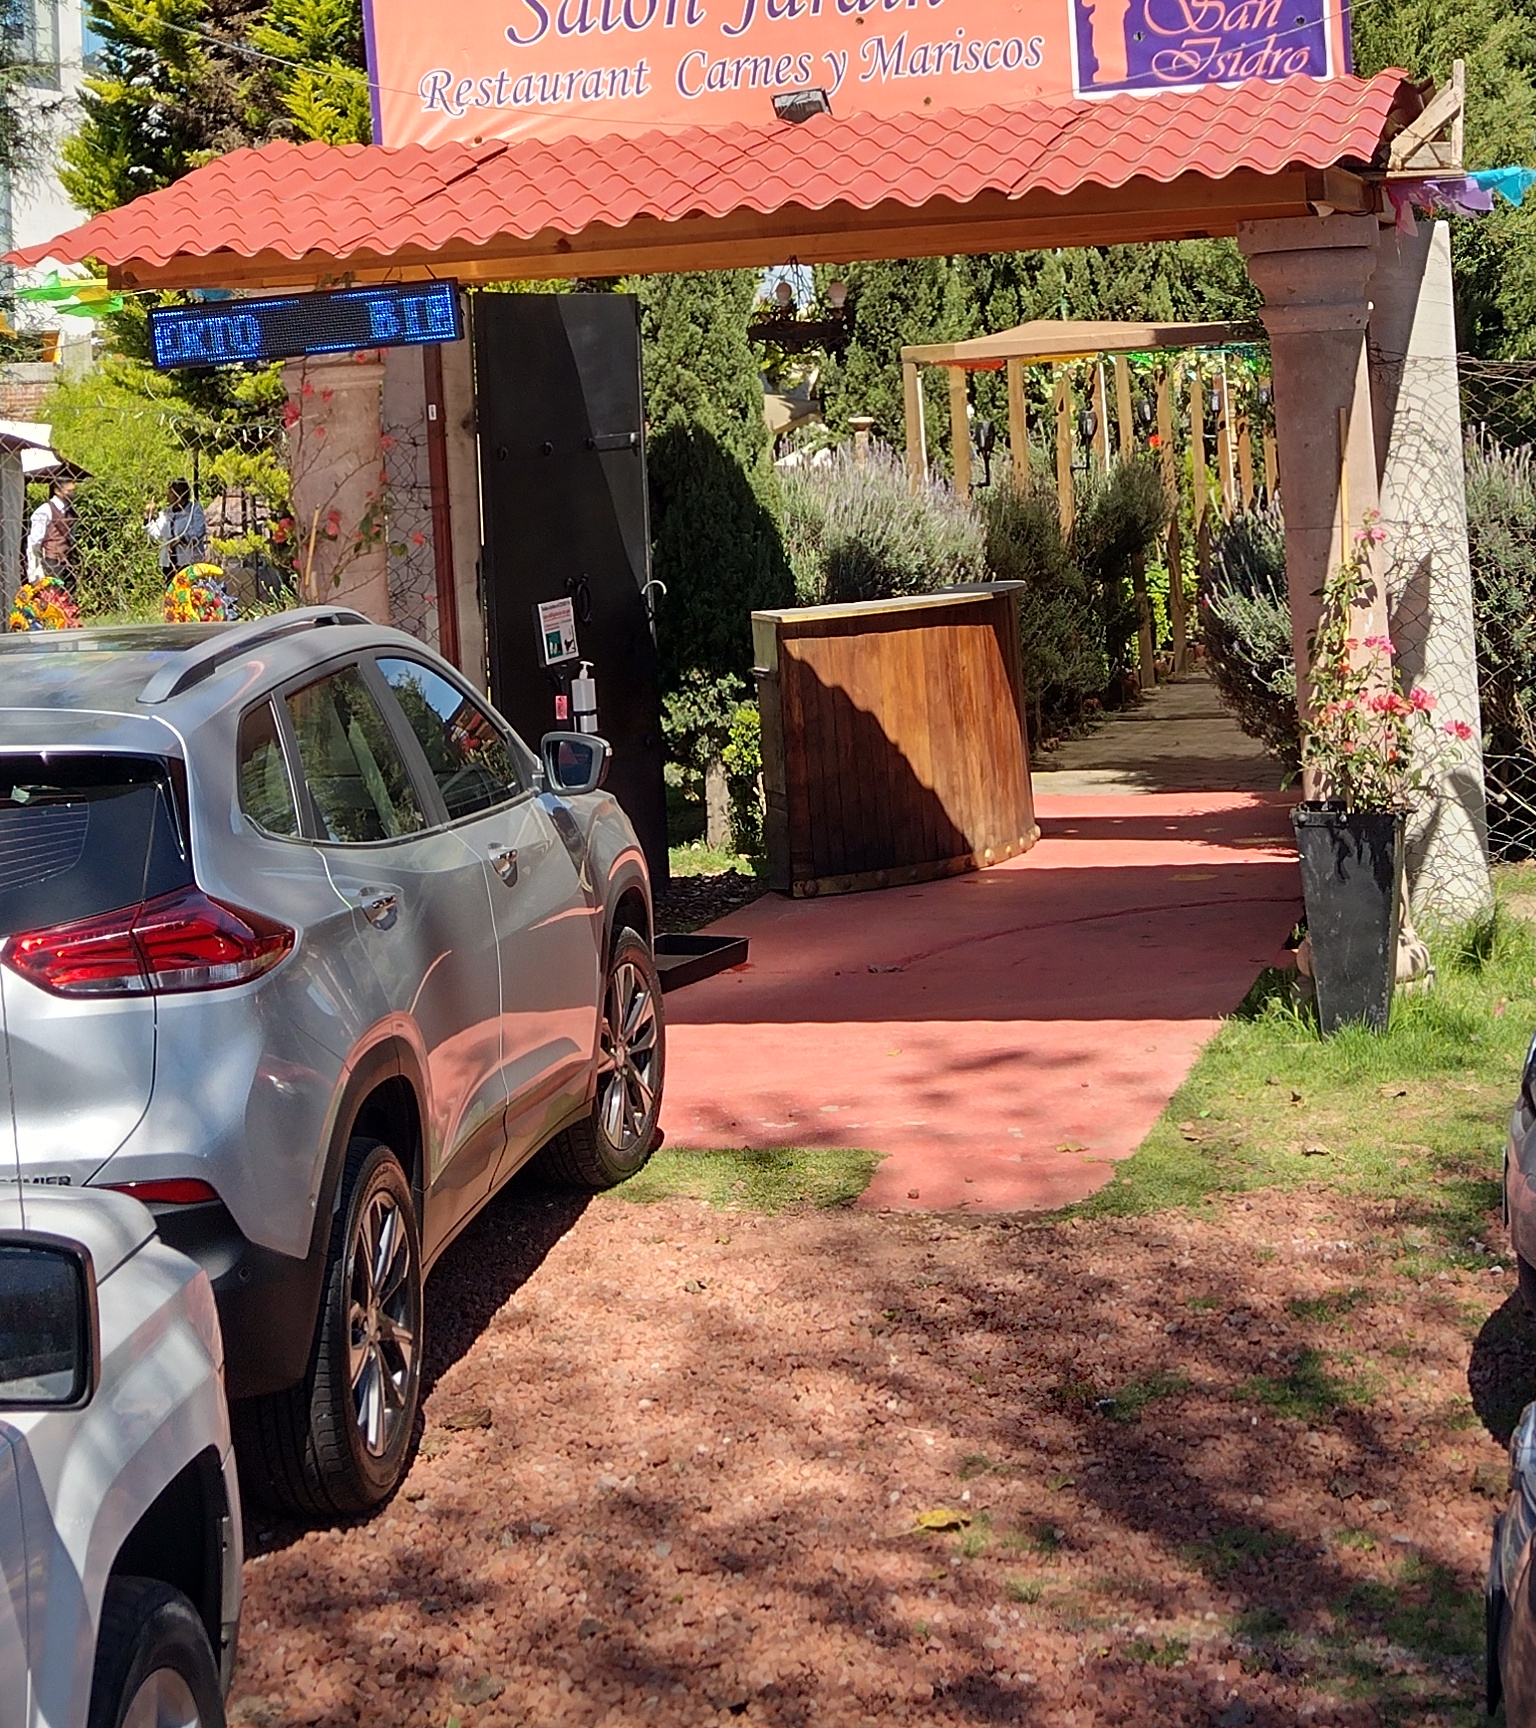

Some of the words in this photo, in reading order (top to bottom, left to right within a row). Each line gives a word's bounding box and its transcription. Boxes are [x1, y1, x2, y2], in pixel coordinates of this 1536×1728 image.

[419, 60, 649, 118] Restaurant
[675, 51, 811, 99] Carnes
[823, 51, 850, 92] y
[861, 30, 1043, 84] Mariscos
[1151, 33, 1311, 82] Isidro
